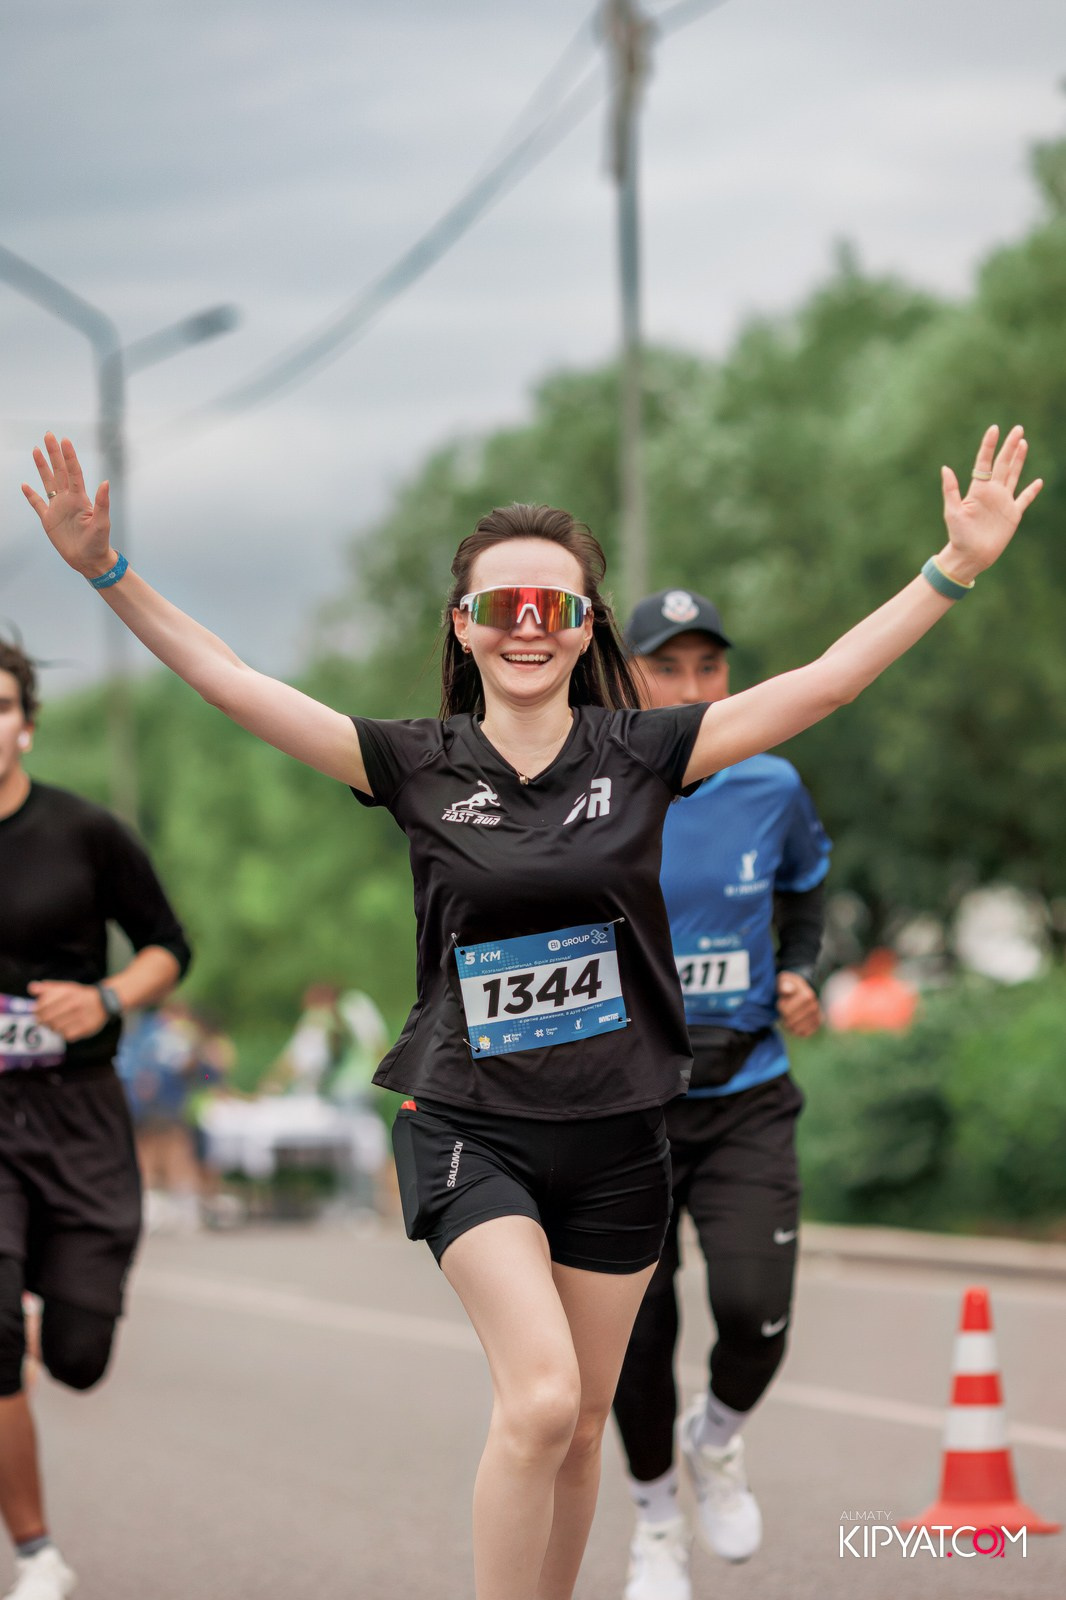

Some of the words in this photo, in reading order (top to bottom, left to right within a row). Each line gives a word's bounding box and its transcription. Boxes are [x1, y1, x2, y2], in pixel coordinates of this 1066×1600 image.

[441, 810, 474, 823] FAST
[472, 815, 501, 826] RUN
[562, 934, 590, 947] GROUP
[464, 951, 476, 965] 5
[480, 950, 501, 963] KM
[483, 958, 602, 1018] 1344
[446, 1140, 464, 1188] SALOMON
